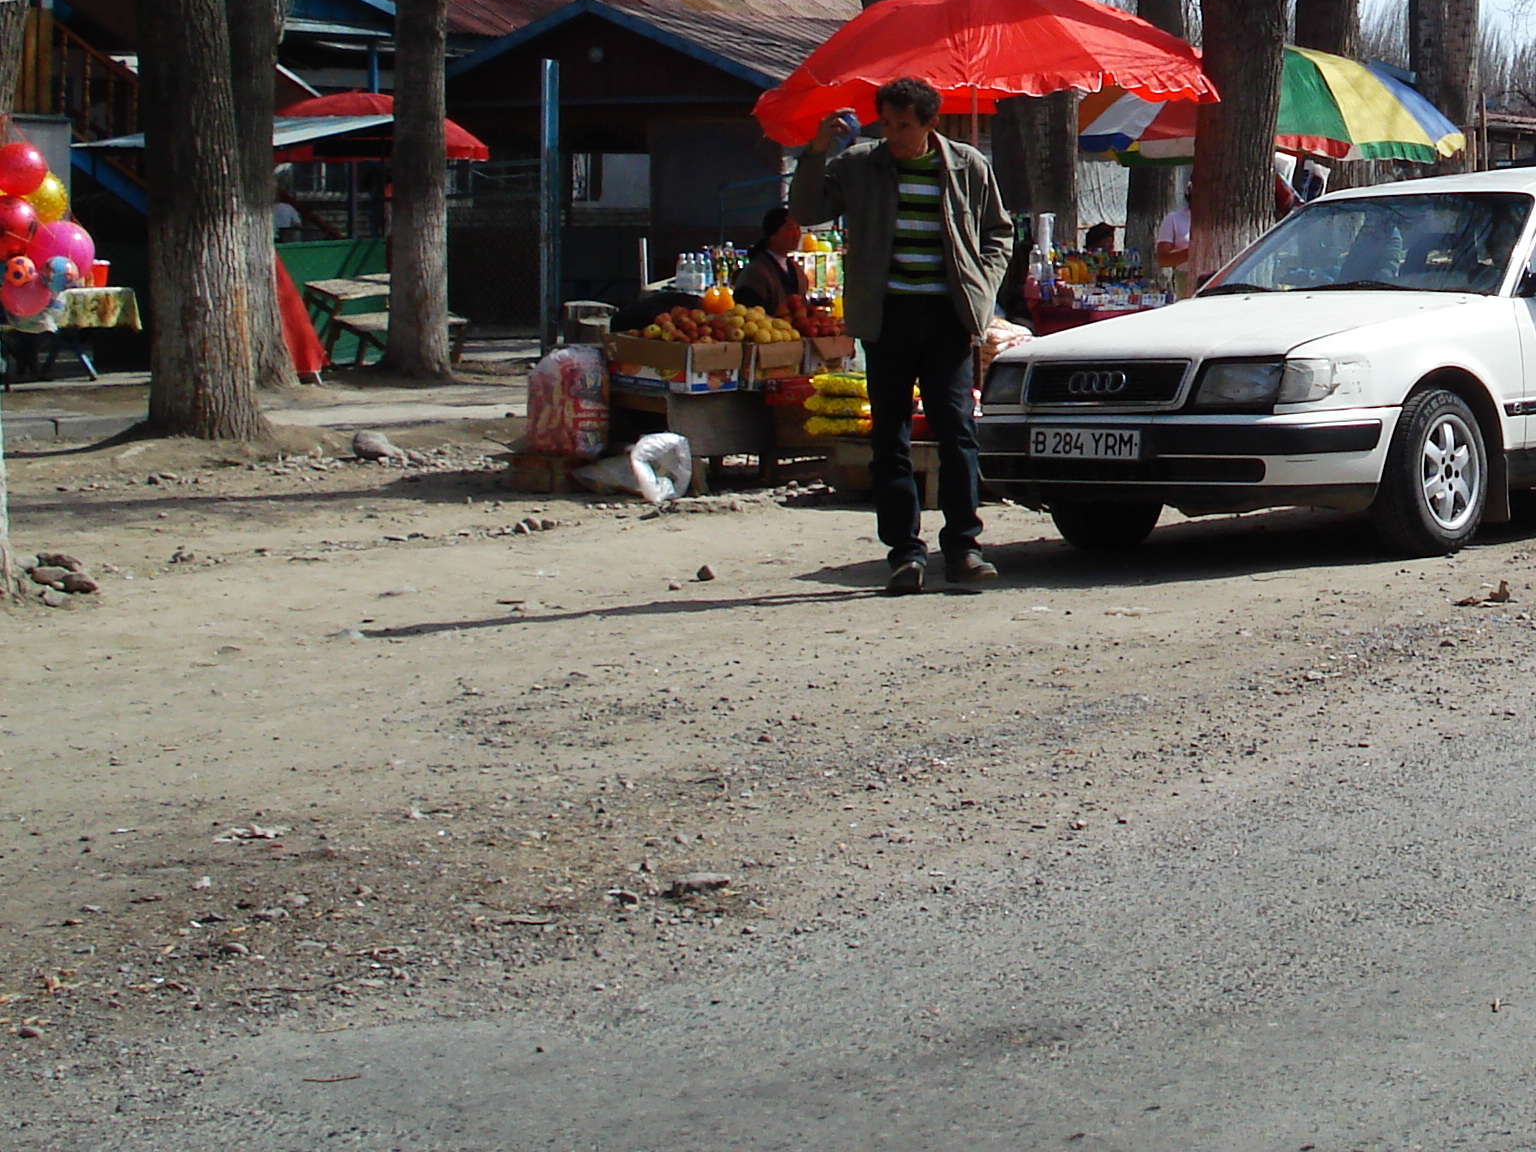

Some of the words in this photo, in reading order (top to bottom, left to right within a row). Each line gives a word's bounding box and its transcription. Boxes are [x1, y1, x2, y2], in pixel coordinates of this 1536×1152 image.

[1035, 431, 1047, 454] B
[1052, 432, 1084, 455] 284
[1091, 432, 1134, 456] YRM
